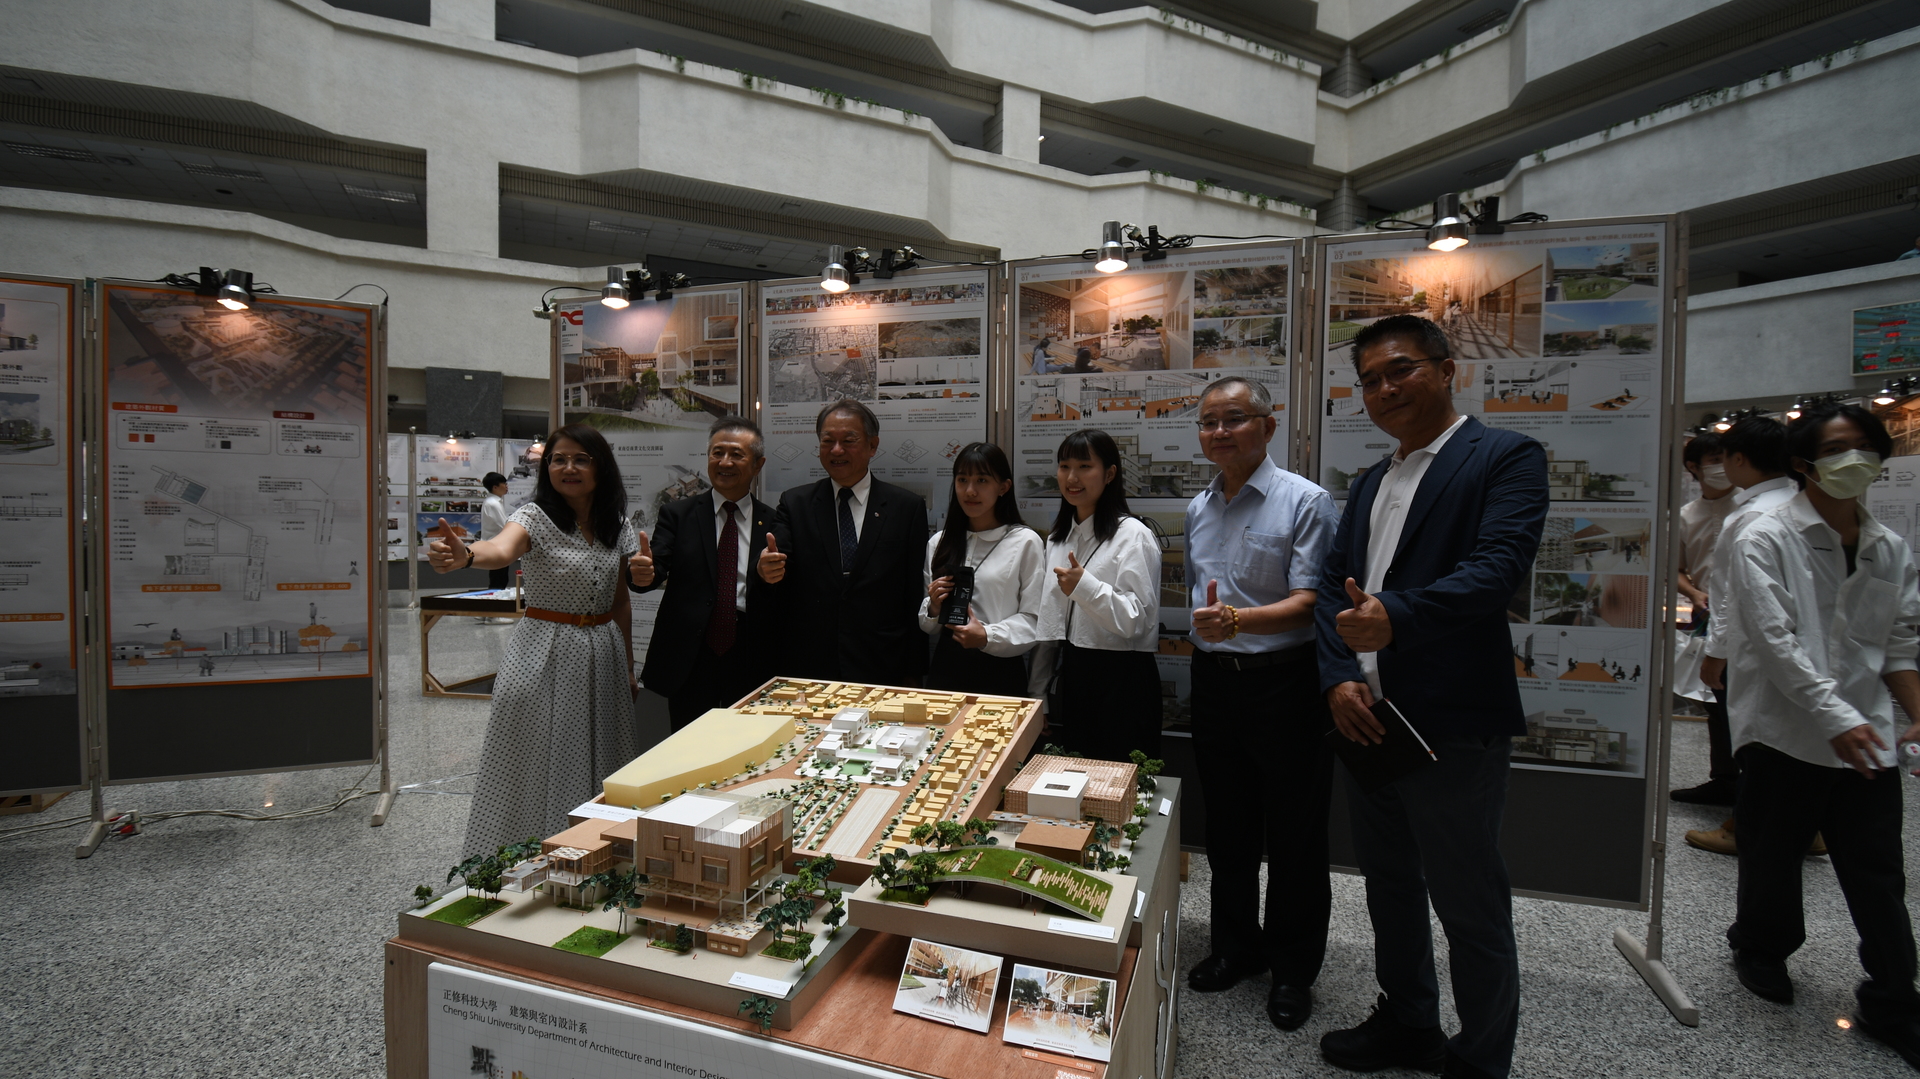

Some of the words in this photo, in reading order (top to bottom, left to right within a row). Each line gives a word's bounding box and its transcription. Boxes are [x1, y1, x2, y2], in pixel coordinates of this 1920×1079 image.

[443, 988, 498, 1012] 正修科技大學
[510, 1005, 588, 1034] 建築與室內設計系
[443, 1004, 468, 1020] Cheng
[470, 1010, 486, 1022] Shiu
[488, 1015, 526, 1034] University
[528, 1026, 577, 1046] Department
[578, 1040, 588, 1048] of
[590, 1041, 642, 1062] Architecture
[644, 1058, 662, 1068] and
[664, 1060, 697, 1077] Interior
